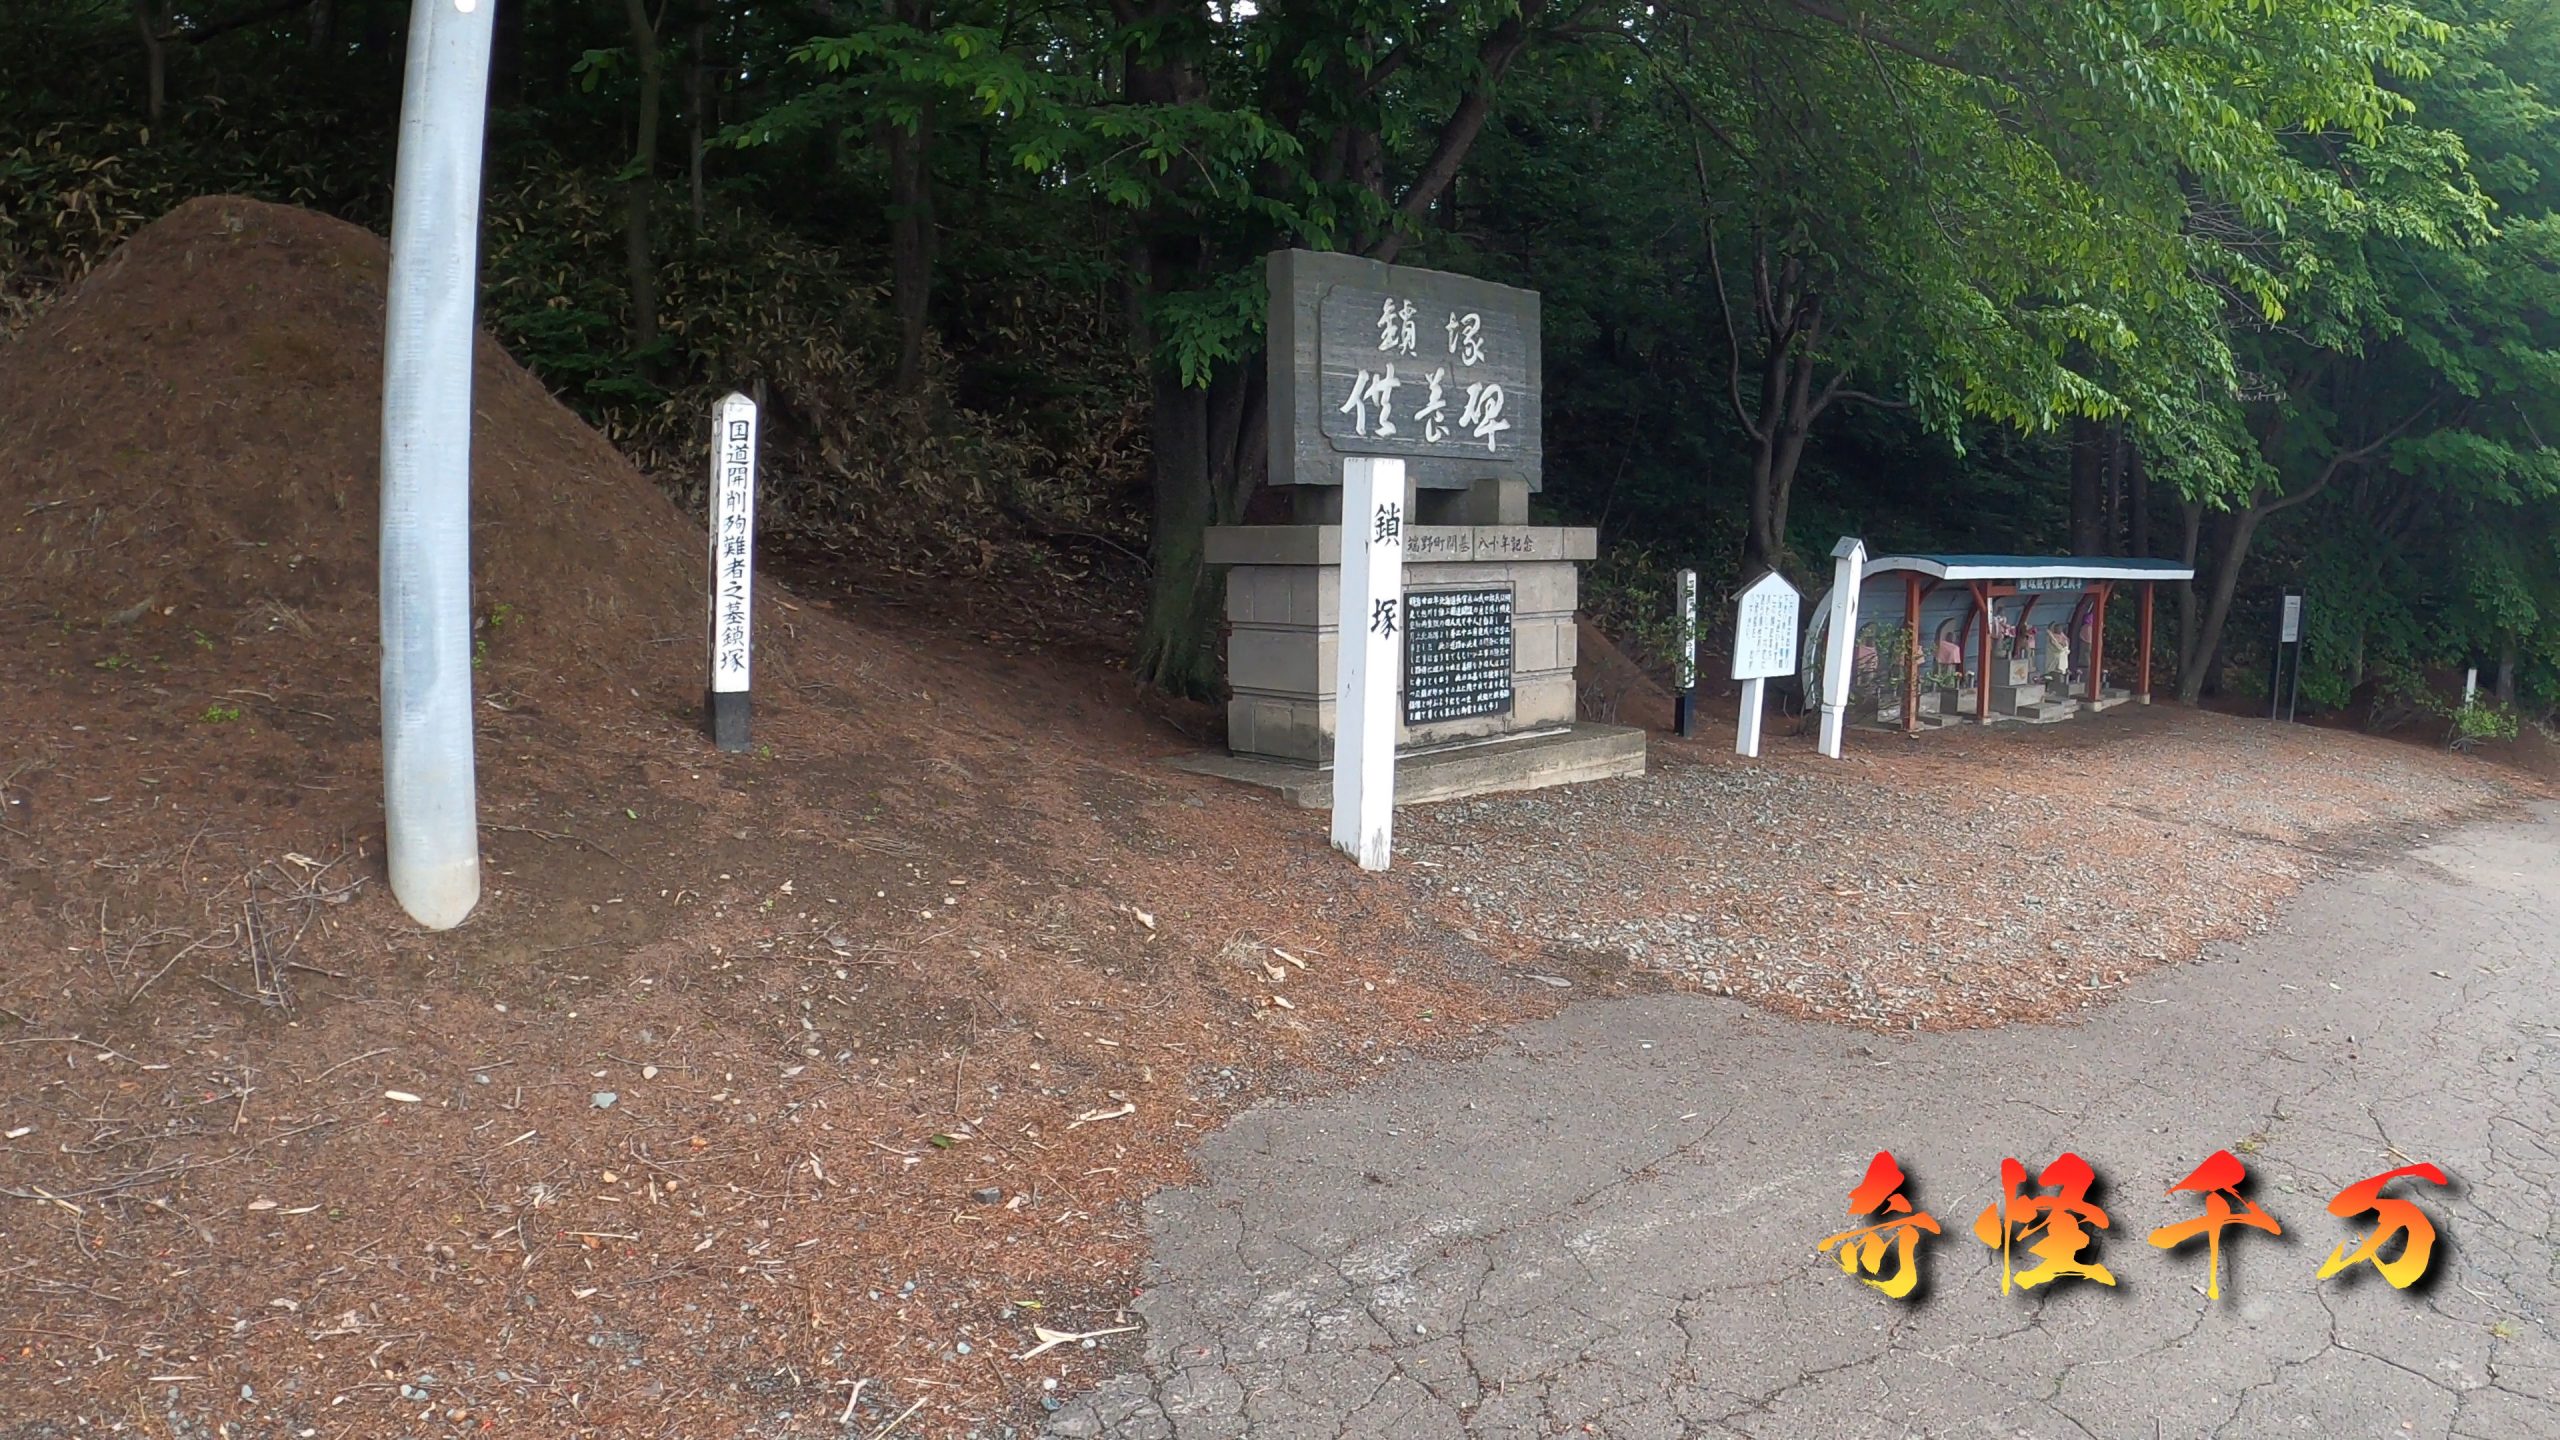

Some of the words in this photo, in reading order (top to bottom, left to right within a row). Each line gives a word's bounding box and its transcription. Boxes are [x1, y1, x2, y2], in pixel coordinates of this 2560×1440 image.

[1339, 363, 1511, 453] 供養碑
[720, 419, 750, 671] 国道開削殉難者之墓鎖塚
[1371, 502, 1401, 642] 鎖塚
